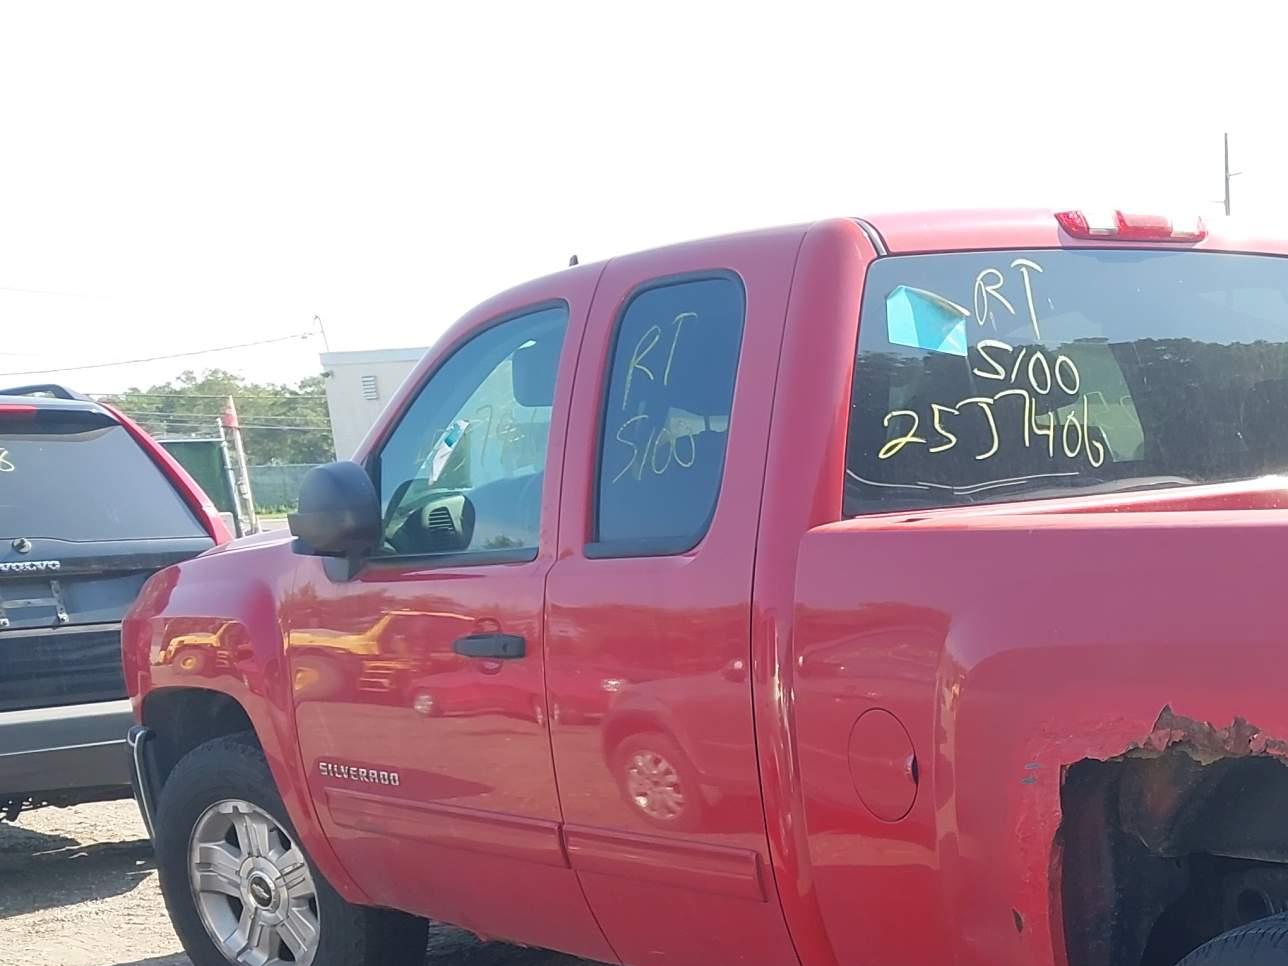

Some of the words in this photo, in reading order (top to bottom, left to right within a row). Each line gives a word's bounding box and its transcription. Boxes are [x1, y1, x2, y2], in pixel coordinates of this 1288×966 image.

[973, 258, 1042, 341] RT
[622, 312, 698, 412] RT
[318, 762, 400, 786] SILVERADO
